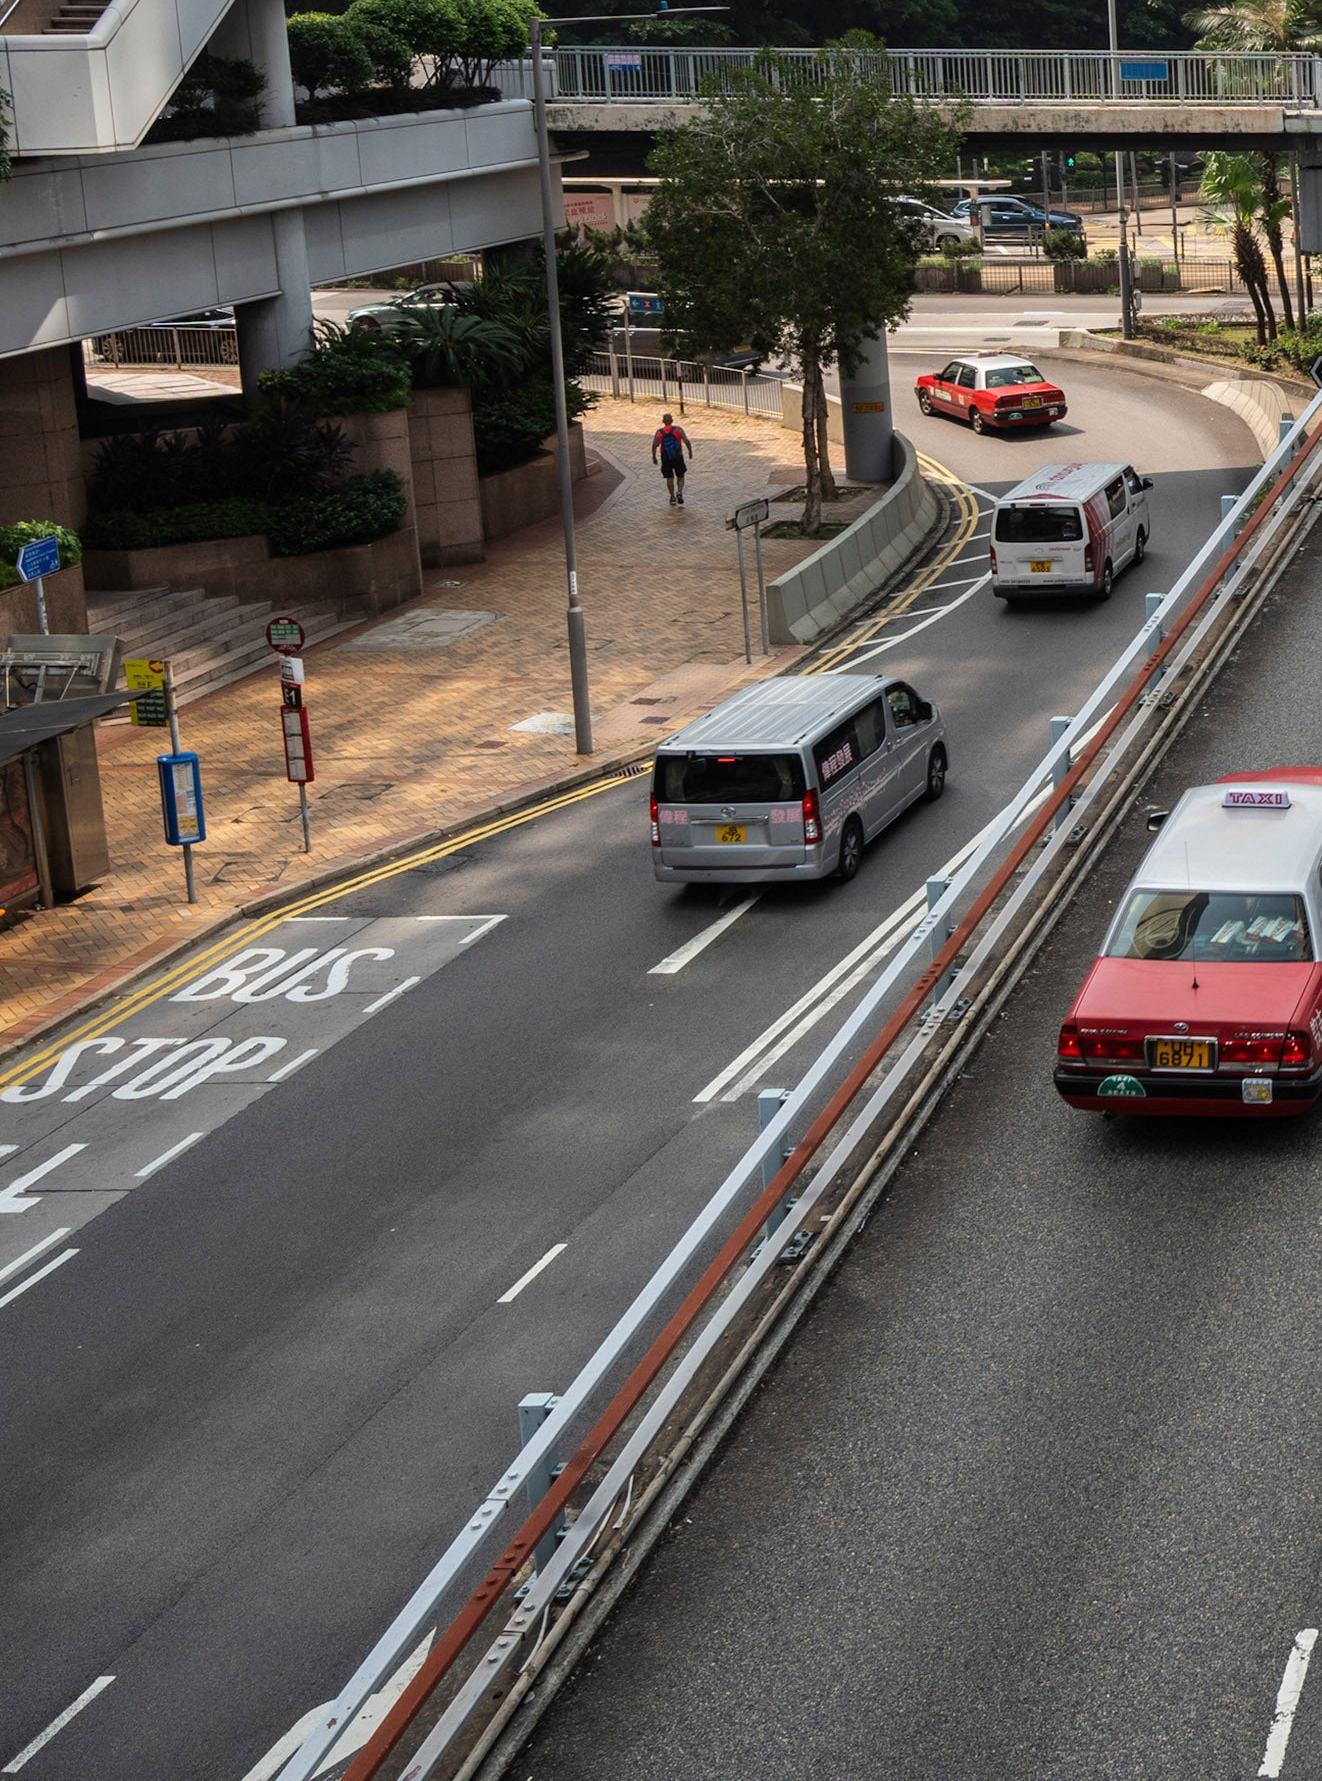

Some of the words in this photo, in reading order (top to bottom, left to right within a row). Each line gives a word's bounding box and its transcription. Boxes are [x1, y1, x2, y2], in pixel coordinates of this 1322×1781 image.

[1230, 792, 1283, 804] TAXI
[721, 833, 741, 842] 672
[169, 947, 395, 1002] BUS
[1160, 1052, 1202, 1067] 6871
[0, 1036, 288, 1103] STOP
[1111, 1074, 1137, 1082] TAXI
